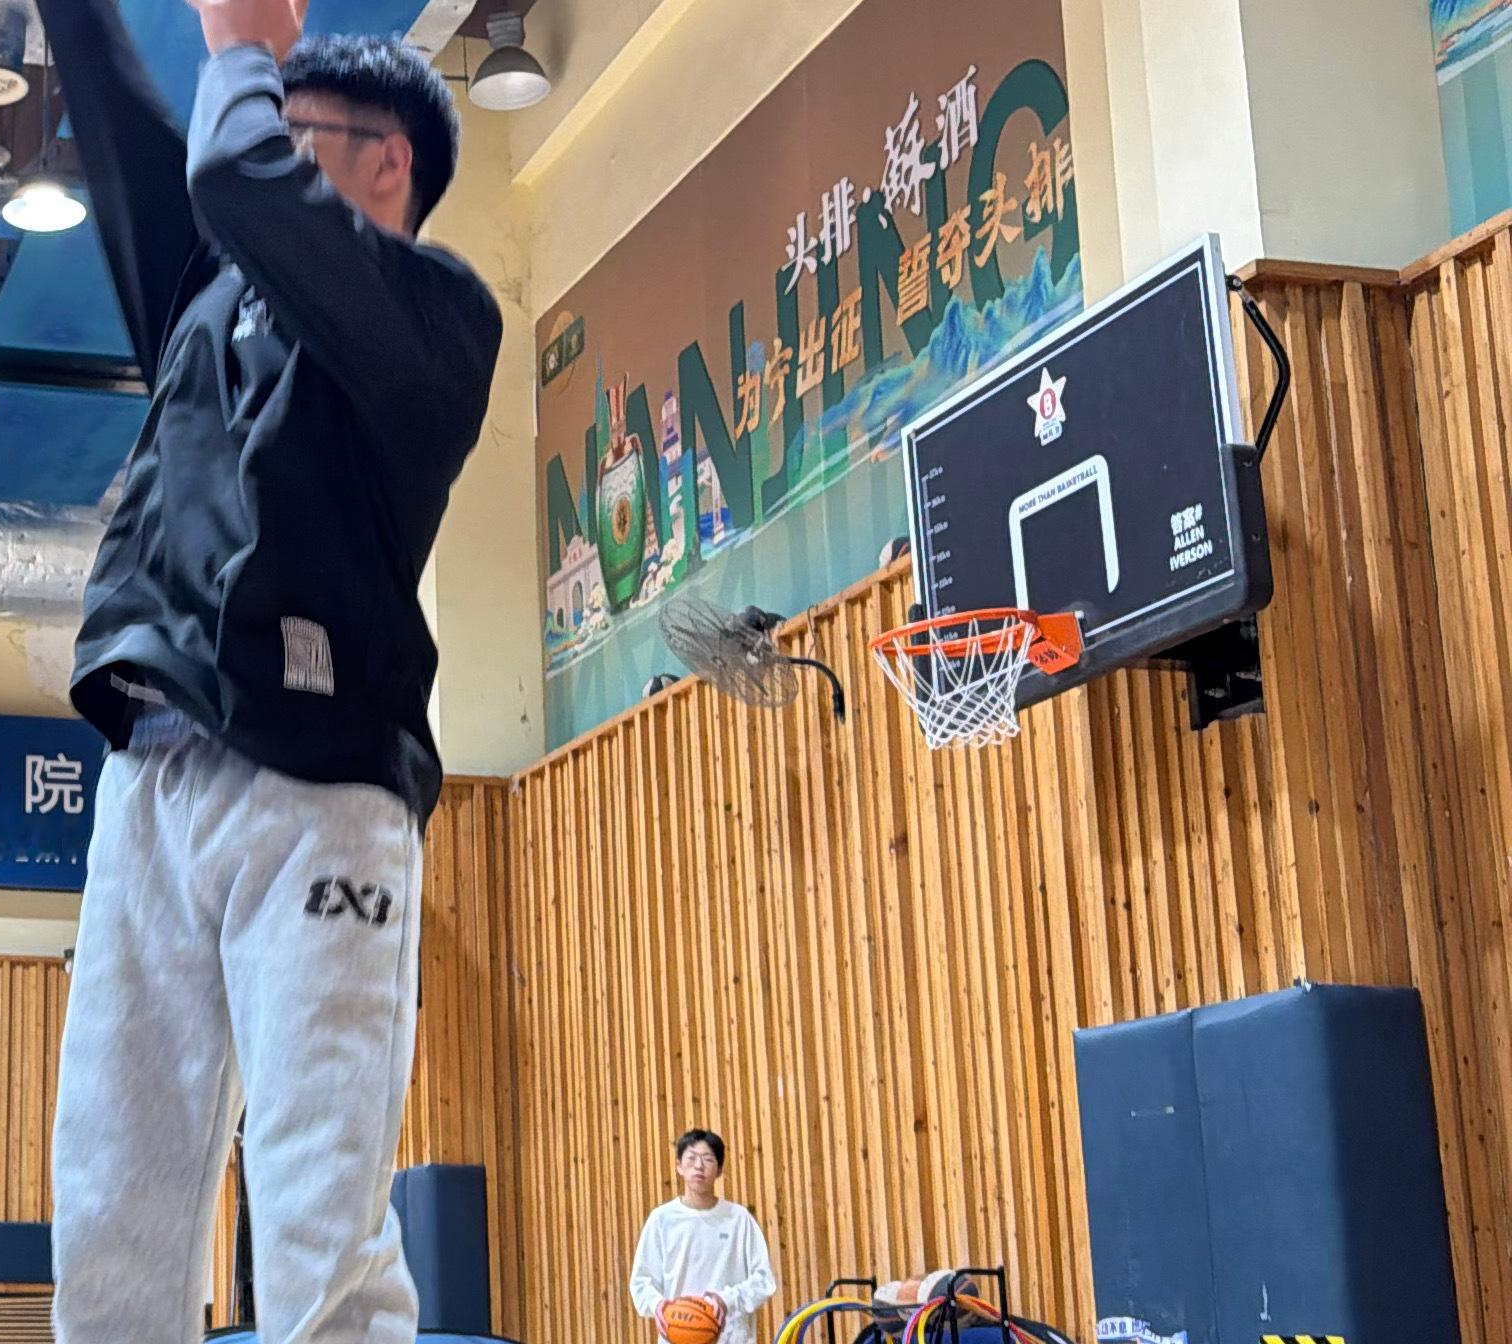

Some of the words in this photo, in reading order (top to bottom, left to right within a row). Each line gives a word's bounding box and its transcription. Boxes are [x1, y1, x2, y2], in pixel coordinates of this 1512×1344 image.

[735, 287, 863, 440] 为宁出征
[896, 137, 1073, 327] 誓夺头排
[1174, 524, 1205, 552] ALLEN
[1169, 539, 1213, 572] IVERSON
